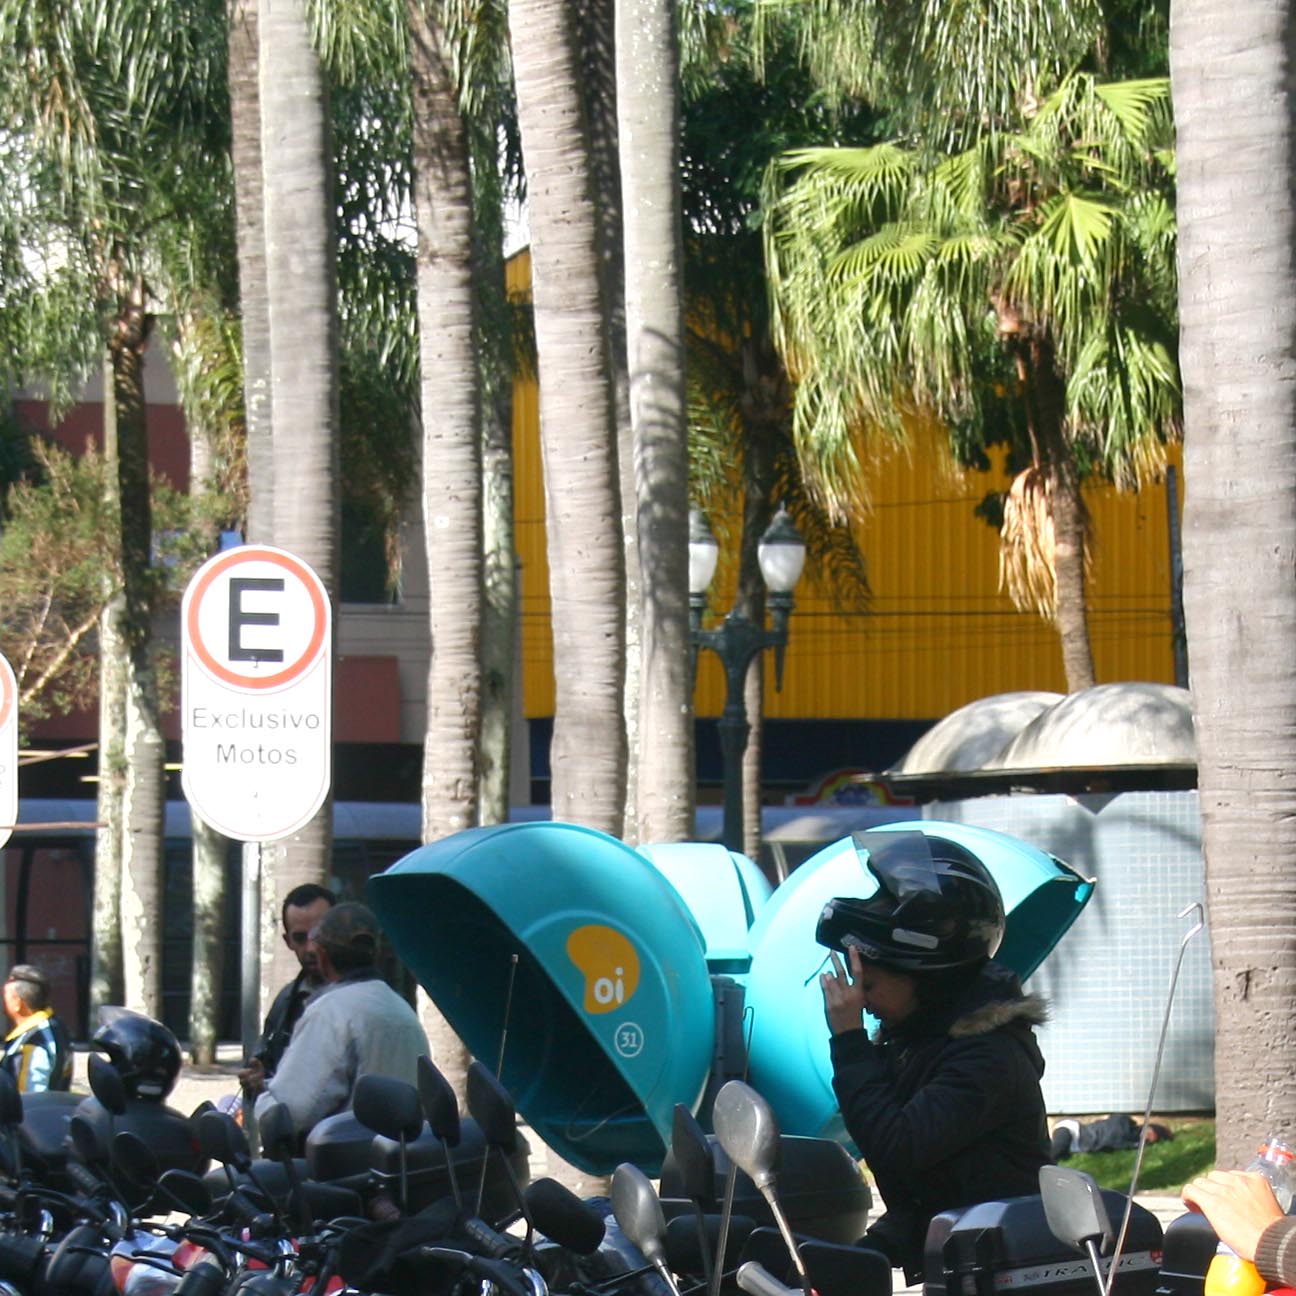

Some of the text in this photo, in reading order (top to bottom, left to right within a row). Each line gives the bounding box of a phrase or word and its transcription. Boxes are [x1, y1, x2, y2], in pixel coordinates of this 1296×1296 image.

[228, 578, 285, 663] E
[193, 707, 321, 730] Exclusivo
[217, 743, 298, 764] Motos
[594, 966, 625, 1005] oi
[620, 1031, 638, 1048] 31
